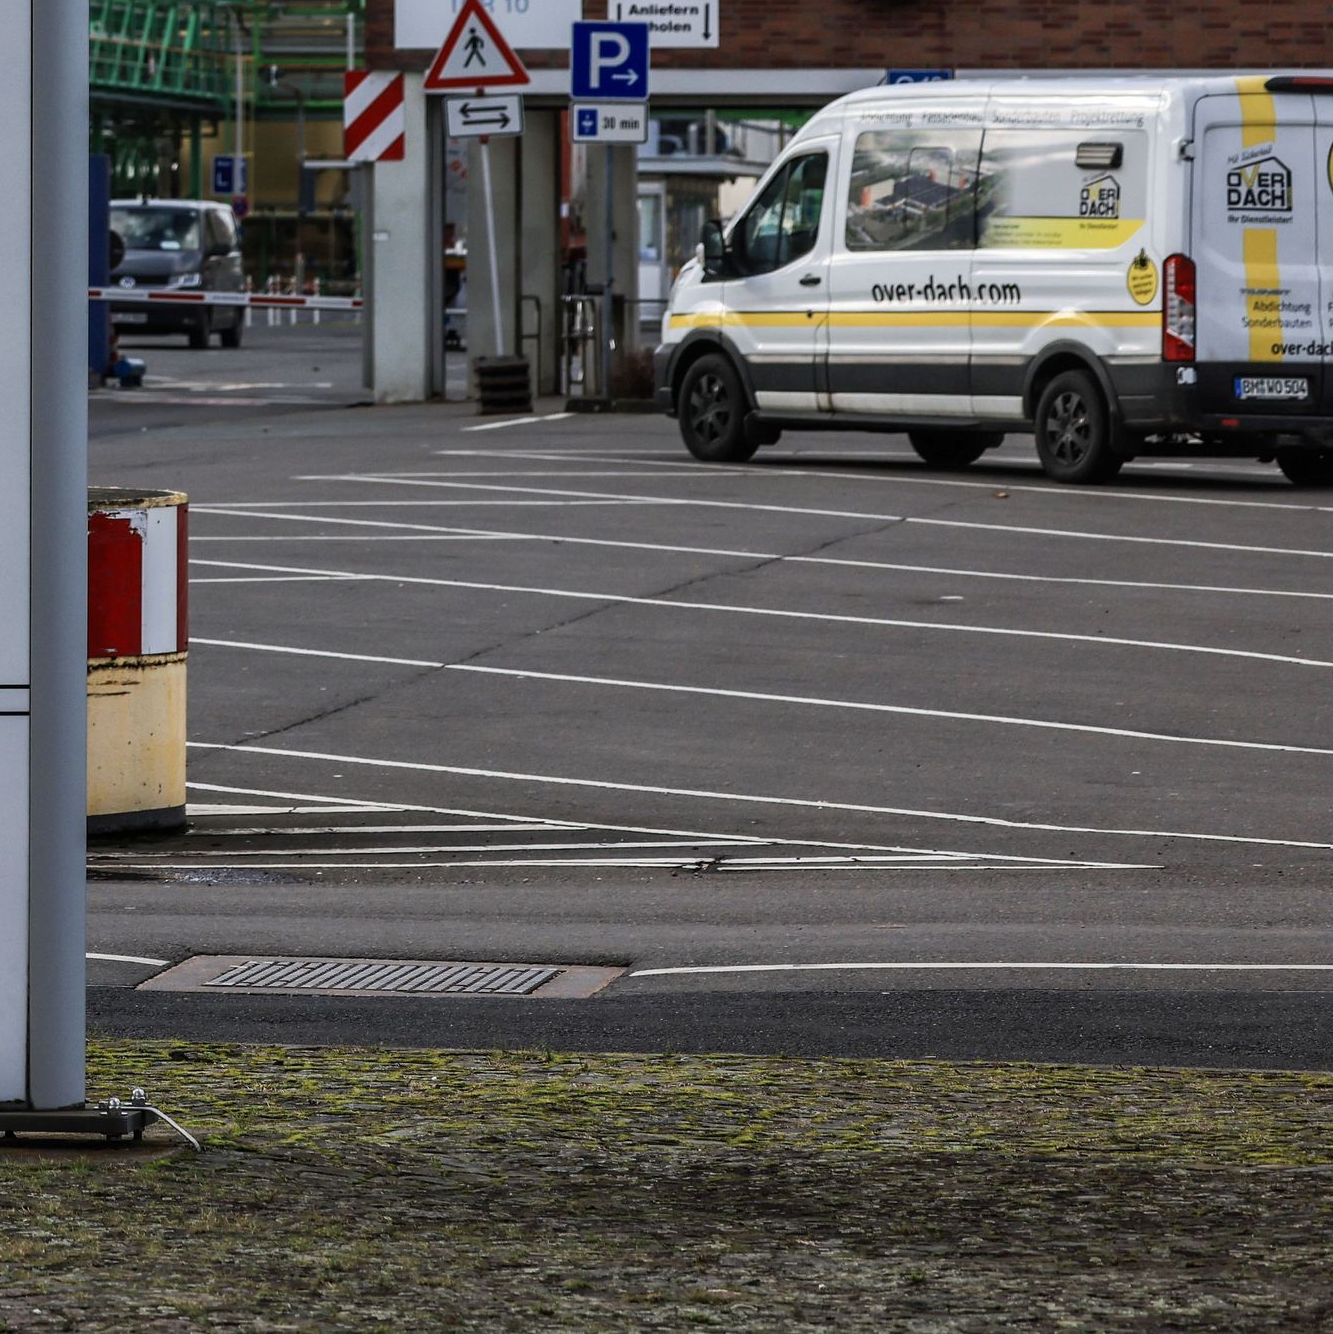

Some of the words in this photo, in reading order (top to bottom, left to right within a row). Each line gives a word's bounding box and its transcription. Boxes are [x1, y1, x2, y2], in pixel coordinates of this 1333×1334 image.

[629, 4, 699, 16] Anliefern
[589, 31, 631, 88] P
[619, 117, 640, 130] min
[1227, 164, 1285, 188] OVER
[1227, 188, 1285, 207] DACH
[1080, 201, 1116, 216] DACH
[871, 274, 1022, 305] over-dach.com
